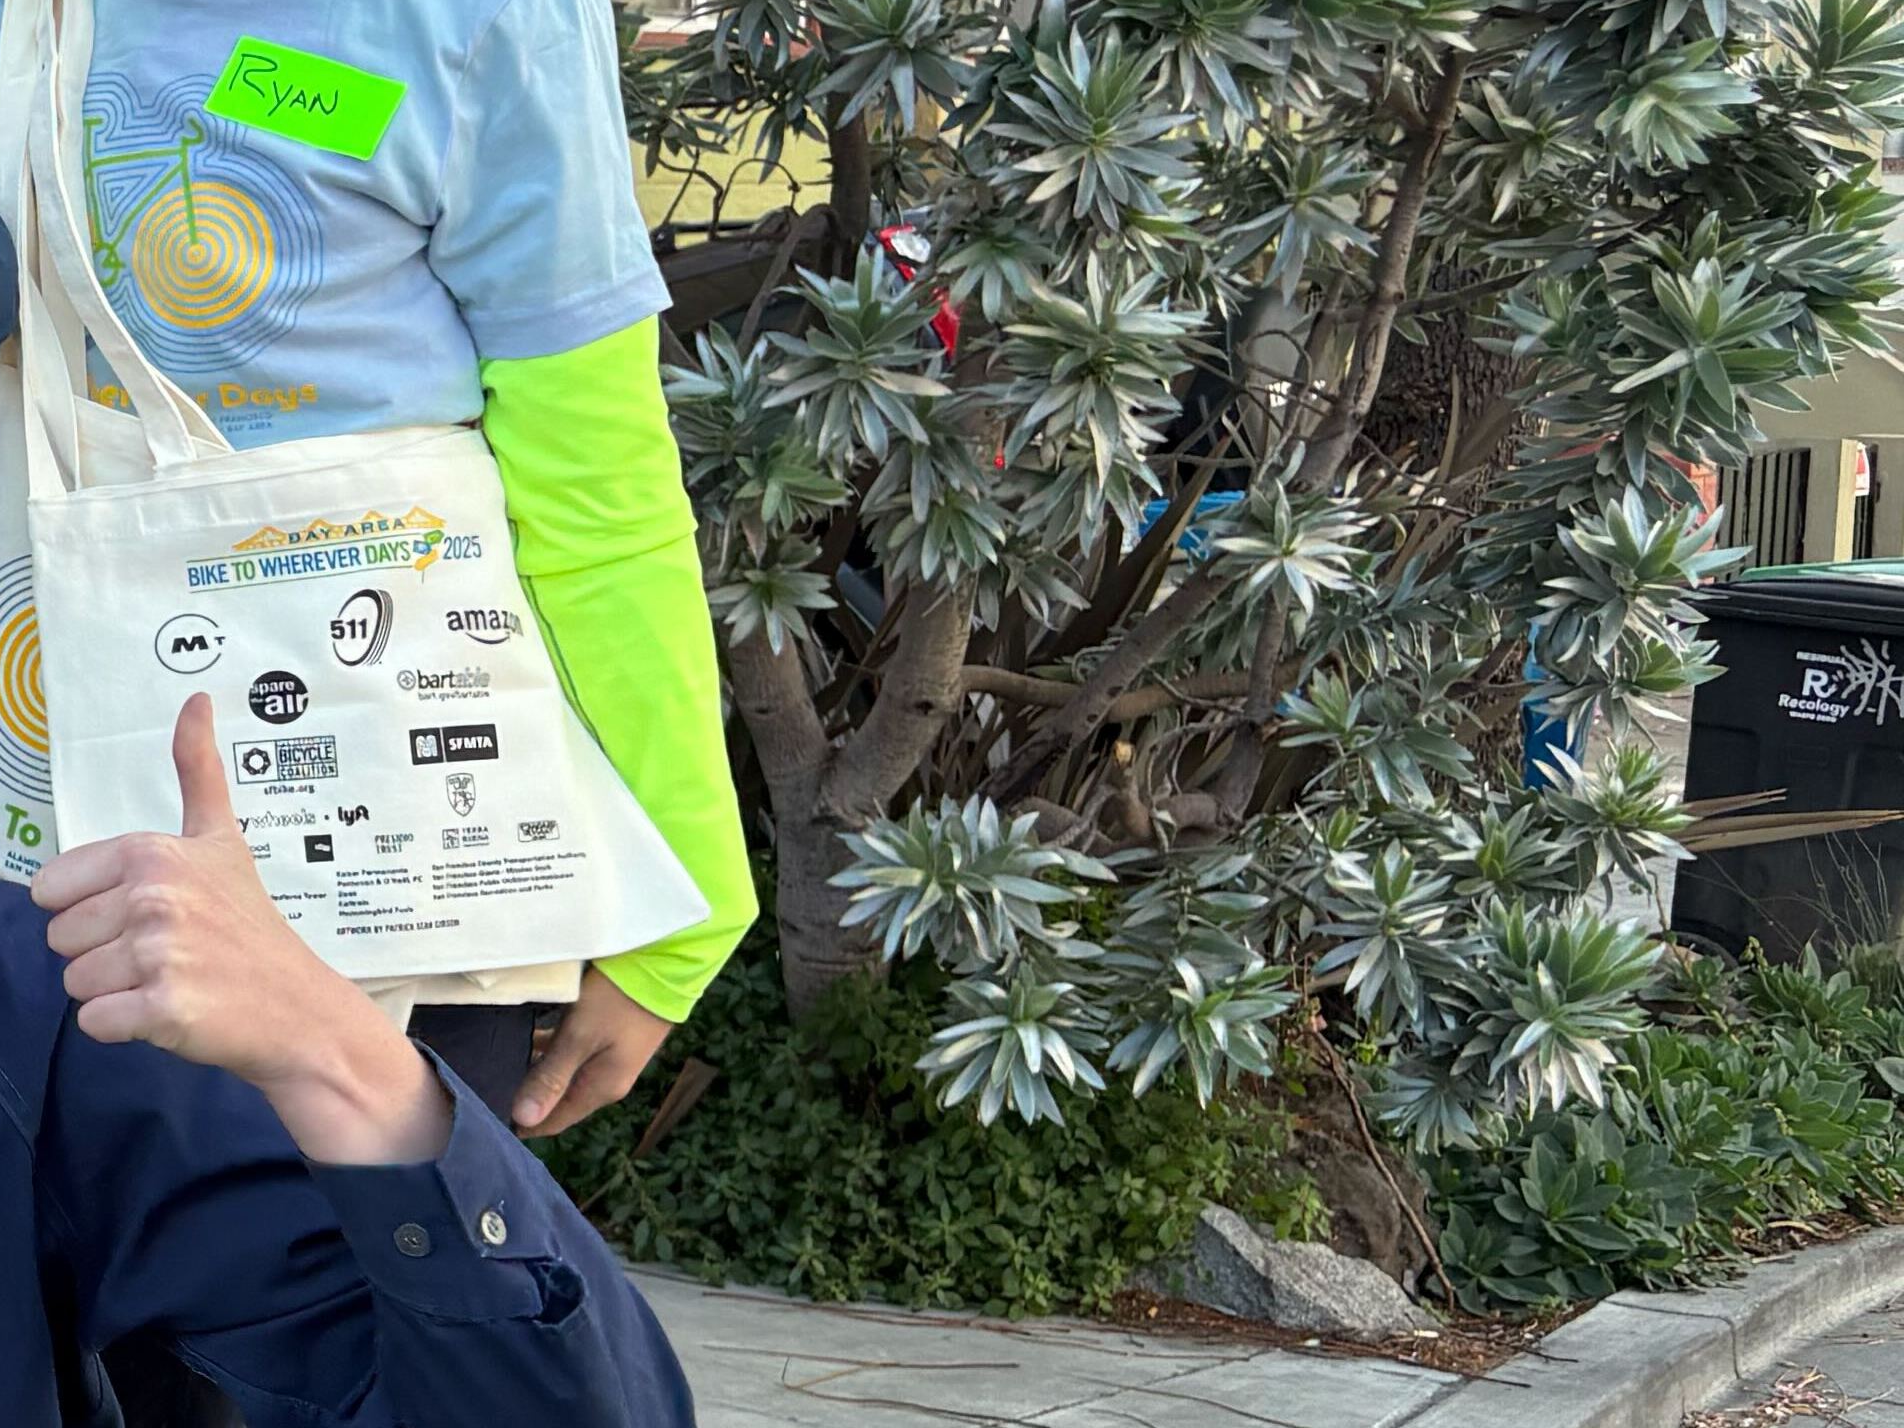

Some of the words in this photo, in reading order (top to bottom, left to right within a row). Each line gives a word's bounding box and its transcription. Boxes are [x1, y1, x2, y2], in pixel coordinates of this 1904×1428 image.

[217, 383, 319, 412] Days
[343, 517, 406, 537] AREA
[187, 562, 230, 588] BIKE
[230, 558, 256, 582] TO
[258, 545, 361, 579] WHEREVER
[364, 539, 412, 564] DAYS
[442, 535, 483, 560] 2025
[330, 618, 369, 640] 511
[264, 690, 309, 716] air
[1778, 693, 1850, 718] Recology
[279, 744, 334, 764] BICYCLE
[448, 733, 493, 751] SFMTA
[4, 803, 42, 848] To
